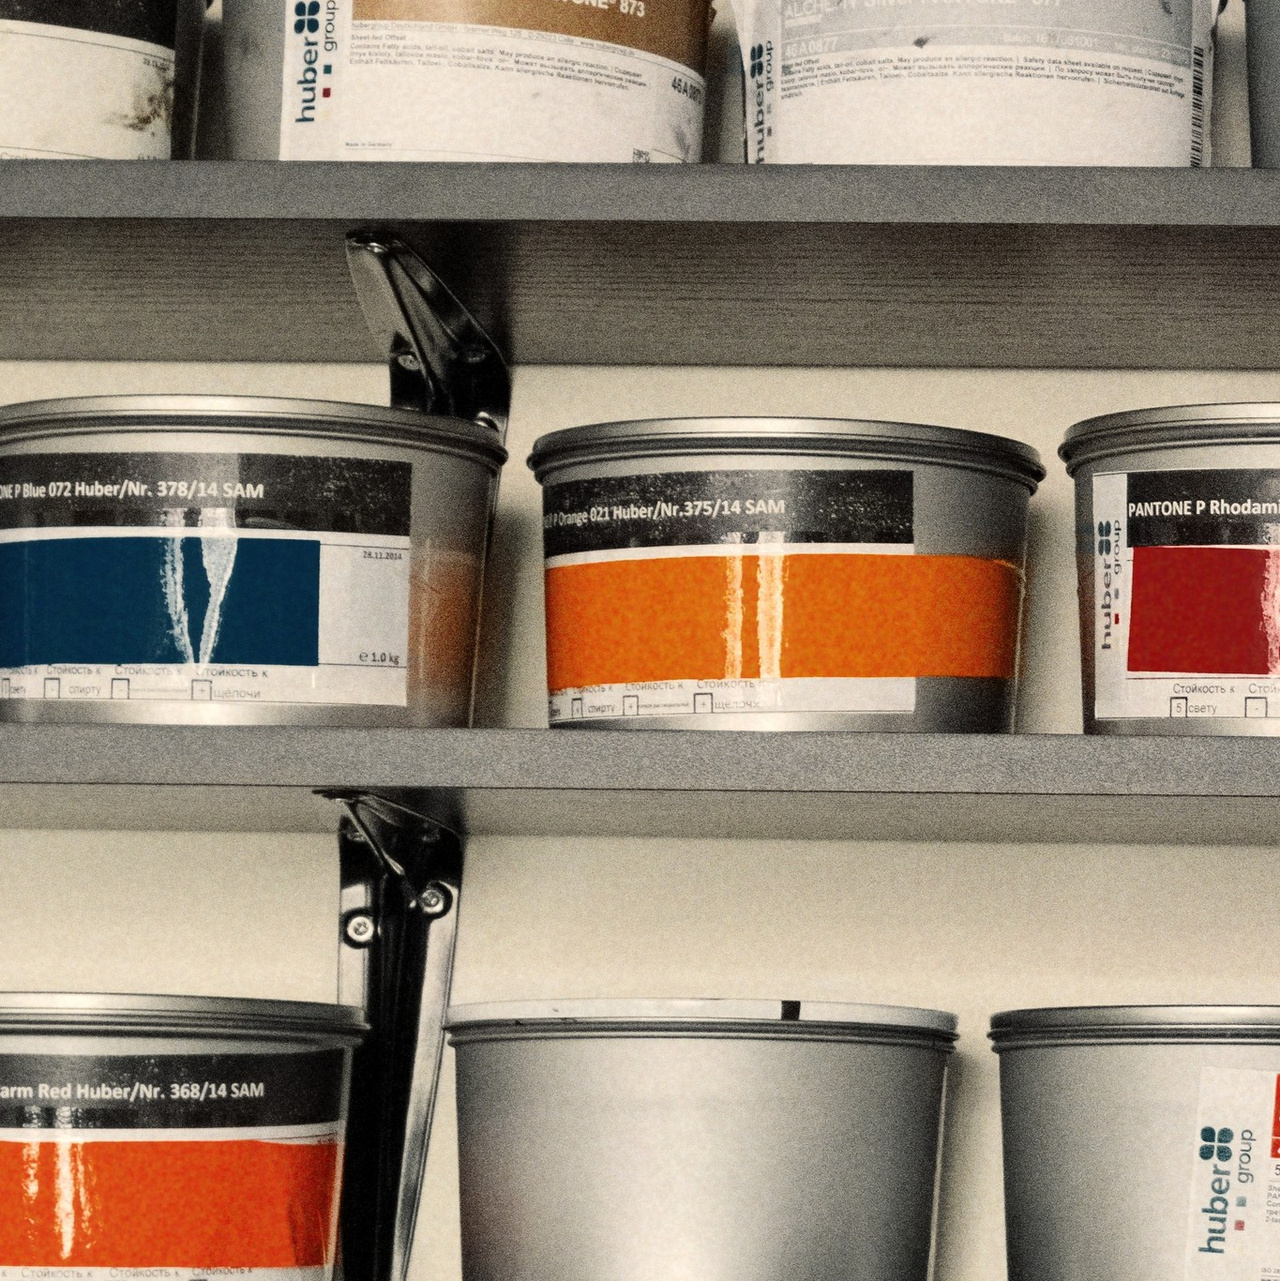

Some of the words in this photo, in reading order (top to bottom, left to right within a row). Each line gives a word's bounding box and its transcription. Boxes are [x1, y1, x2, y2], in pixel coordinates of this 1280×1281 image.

[324, 0, 338, 52] group
[295, 37, 320, 123] huber
[24, 484, 46, 499] Blue
[49, 482, 71, 497] 072
[75, 482, 153, 499] Huber/Nr.
[157, 481, 217, 499] 378/14
[223, 482, 264, 498] SAM
[559, 511, 587, 526] Orange
[591, 505, 610, 521] 021
[745, 499, 785, 514] SAM
[1128, 502, 1191, 517] PANTONE
[1196, 502, 1205, 516] P
[1113, 519, 1122, 576] group
[1101, 559, 1112, 650] huber
[371, 652, 386, 663] 1.0
[389, 652, 399, 666] kg
[1173, 683, 1226, 695] Стойкость
[1189, 704, 1218, 716] свету
[38, 1084, 72, 1097] Red
[76, 1084, 165, 1101] Huber/Nr.
[171, 1082, 227, 1100] 368/14
[231, 1083, 264, 1097] SAM
[1236, 1129, 1256, 1184] group
[1199, 1164, 1231, 1254] huber
